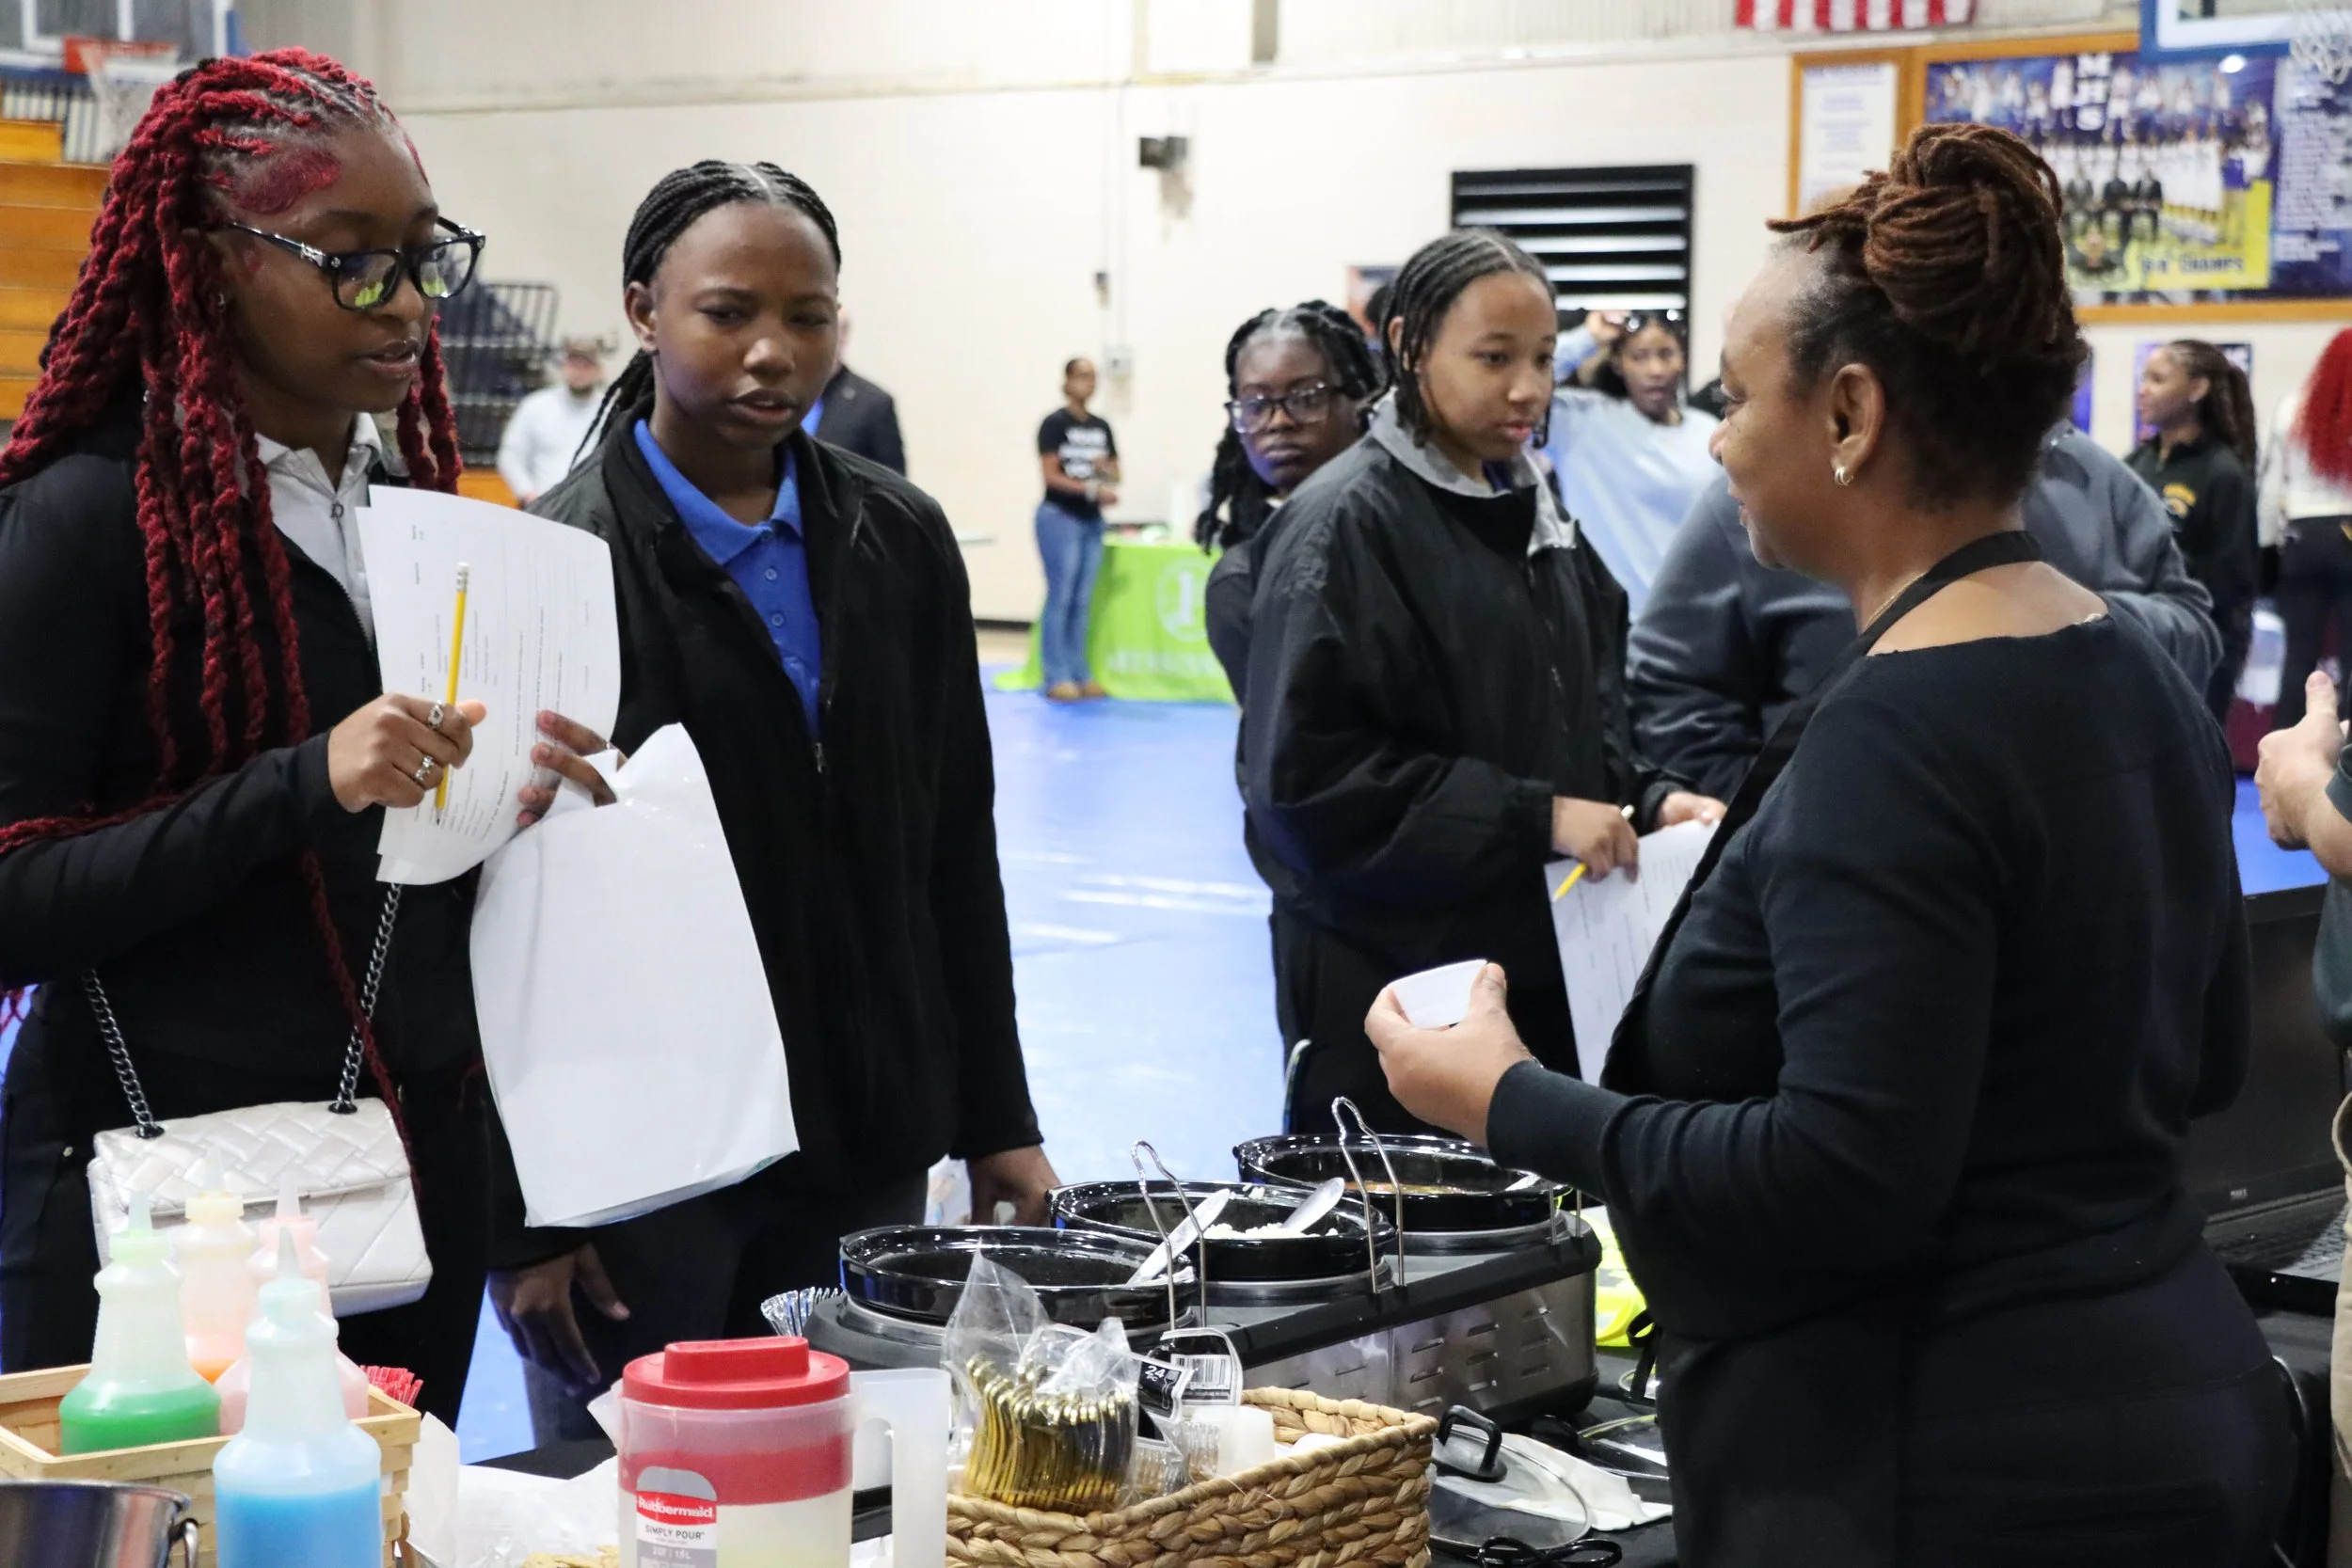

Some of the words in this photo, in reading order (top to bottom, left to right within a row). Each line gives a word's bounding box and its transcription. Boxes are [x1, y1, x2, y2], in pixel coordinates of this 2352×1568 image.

[1145, 1365, 1166, 1379] 24
[638, 1496, 713, 1518] Rubbermaid
[645, 1525, 673, 1537] SIMPLY
